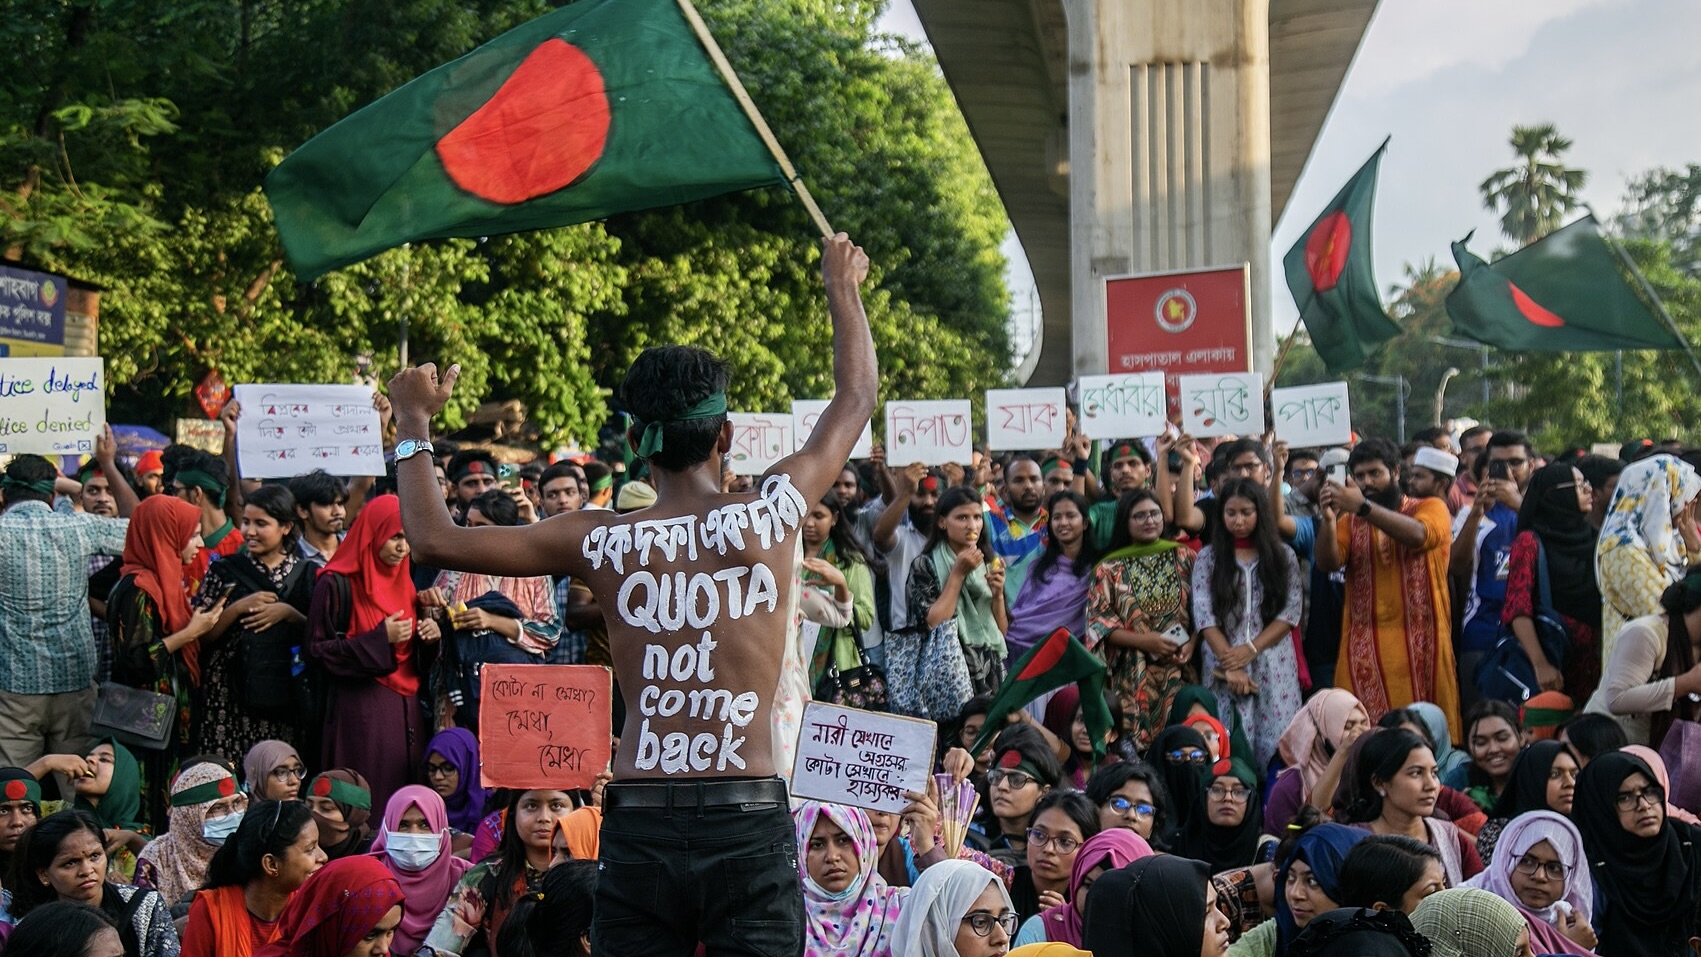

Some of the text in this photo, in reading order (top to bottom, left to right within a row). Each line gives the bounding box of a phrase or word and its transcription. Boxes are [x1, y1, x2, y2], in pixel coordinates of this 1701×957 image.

[1120, 352, 1182, 369] হাসপাতাল
[43, 366, 98, 403] delayed
[1190, 376, 1249, 428] মুক্তি
[36, 408, 95, 433] denied
[889, 406, 967, 450] নিপাত
[998, 403, 1058, 434] যাক
[1279, 396, 1342, 431] পাক
[617, 562, 778, 633] QUOTA
[642, 630, 718, 683] not
[492, 675, 527, 700] কোটা
[531, 683, 548, 700] না
[639, 685, 760, 727] come
[635, 718, 746, 774] back
[812, 714, 895, 750] নারী যেখানে
[538, 745, 591, 777] মেধা
[805, 754, 893, 783] কোটা সেখানে
[846, 779, 905, 803] হাস্যকর
